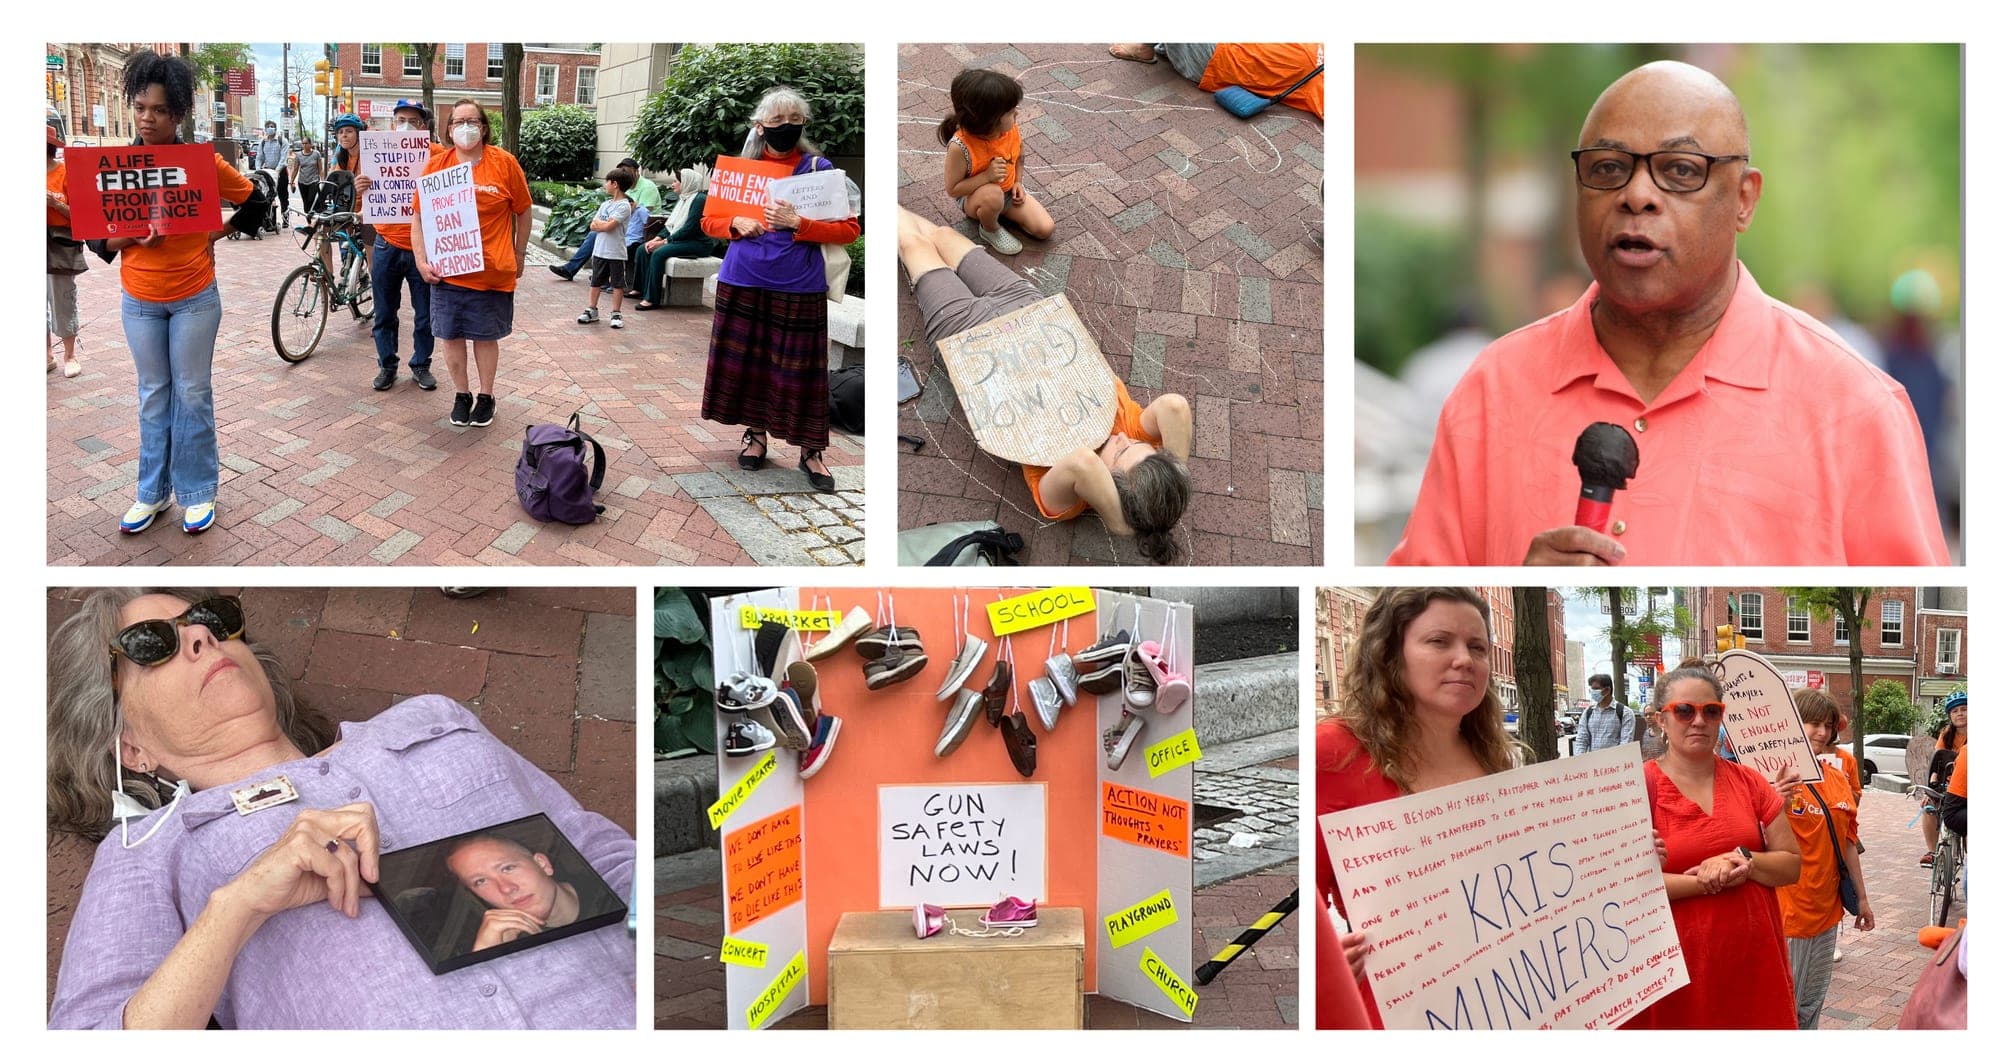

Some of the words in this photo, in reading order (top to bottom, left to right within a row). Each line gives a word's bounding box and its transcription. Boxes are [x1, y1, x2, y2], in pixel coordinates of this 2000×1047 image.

[382, 139, 398, 150] the
[400, 138, 430, 150] GUNS
[98, 156, 110, 168] A
[116, 154, 155, 168] LIFE
[380, 166, 410, 178] PASS
[101, 168, 179, 192] FREE
[369, 180, 380, 190] UN
[384, 180, 416, 190] CONTRO
[422, 176, 441, 194] PRO
[443, 165, 469, 190] LIFE?
[722, 170, 744, 187] CAN
[792, 185, 824, 195] LETTERS
[102, 192, 158, 207] FROM
[162, 189, 202, 204] GUN
[368, 193, 387, 204] GUN
[370, 206, 396, 217] LAWS
[401, 206, 414, 217] NO
[431, 192, 455, 212] PROVE
[458, 186, 474, 204] IT!
[792, 200, 832, 210] OSTCARDS
[102, 204, 200, 222] VIOLENCE
[434, 211, 462, 233] BAN
[434, 228, 480, 256] ASSAULT
[430, 252, 481, 276] WEAPONS
[960, 322, 1078, 386] GUNS
[1058, 388, 1102, 427] NO
[998, 593, 1085, 624] SCHOOL
[1730, 689, 1764, 700] PRAYERS
[1728, 713, 1744, 722] ARE
[1746, 704, 1772, 720] NOT
[1740, 718, 1788, 739] ENOUGH!
[1150, 740, 1190, 768] OFFICE
[1738, 745, 1756, 756] GUN
[1758, 739, 1786, 750] SAFETY
[1754, 752, 1800, 773] NOW!
[924, 793, 984, 816] GUN
[1107, 786, 1157, 812] ACTION
[1162, 802, 1186, 820] NOT
[1404, 806, 1444, 824] BEYOND
[1447, 800, 1462, 810] HIS
[1498, 781, 1540, 798] KRISTOPHER
[1545, 778, 1560, 786] WAS
[1564, 771, 1588, 782] ALWAYS
[1593, 765, 1620, 777] PLEASANT
[1624, 762, 1634, 770] AND
[1420, 835, 1432, 848] HE
[1491, 812, 1500, 822] TO
[1522, 804, 1529, 812] IN
[1532, 800, 1545, 810] THE
[1550, 795, 1573, 806] MIDDLE
[1808, 804, 1824, 815] CEA
[729, 838, 742, 856] WE
[772, 815, 790, 832] HAVE
[922, 840, 1000, 857] LAWS
[1572, 837, 1588, 846] YEAR
[1592, 828, 1618, 840] TEACHERS
[733, 863, 742, 874] TO
[747, 850, 763, 867] LIVE
[767, 840, 784, 856] LIKE
[785, 834, 802, 849] THIS
[1352, 886, 1376, 899] AND
[1384, 875, 1401, 887] HIS
[1407, 860, 1446, 879] PLEASANT
[1450, 840, 1492, 862] PERSONALITY
[1496, 830, 1520, 844] EARNED
[1538, 820, 1548, 830] THE
[1552, 814, 1576, 824] RESPECT
[1592, 804, 1616, 815] TEACHERS
[730, 888, 744, 904] WE
[779, 860, 800, 880] HAVE
[1461, 842, 1574, 943] KRIS
[732, 912, 742, 924] TO
[746, 900, 760, 918] DIE
[764, 888, 780, 906] LIKE
[784, 878, 802, 896] THIS
[1362, 914, 1382, 930] ONE
[1390, 908, 1400, 918] OF
[1406, 900, 1418, 910] HIS
[1424, 888, 1450, 904] SENIOR
[1108, 897, 1172, 936] PLAYGROUND
[1368, 944, 1376, 954] A
[1424, 920, 1432, 928] AS
[1438, 912, 1448, 922] HE
[1374, 961, 1406, 982] PERIOD
[1428, 941, 1444, 952] HER
[1426, 902, 1629, 1030] MINNERS
[750, 966, 800, 1022] HOSPITAL
[1146, 958, 1195, 1010] CHURCH
[1386, 989, 1414, 1010] SMILE
[1422, 977, 1437, 990] AND
[1442, 963, 1460, 978] COULD
[1554, 1005, 1572, 1022] PAT
[1576, 978, 1614, 1006] TOOMEY?
[1618, 973, 1628, 982] DO
[1630, 963, 1644, 976] YOU
[1646, 952, 1662, 966] EVEN
[1637, 968, 1674, 999] TOOMEY?
